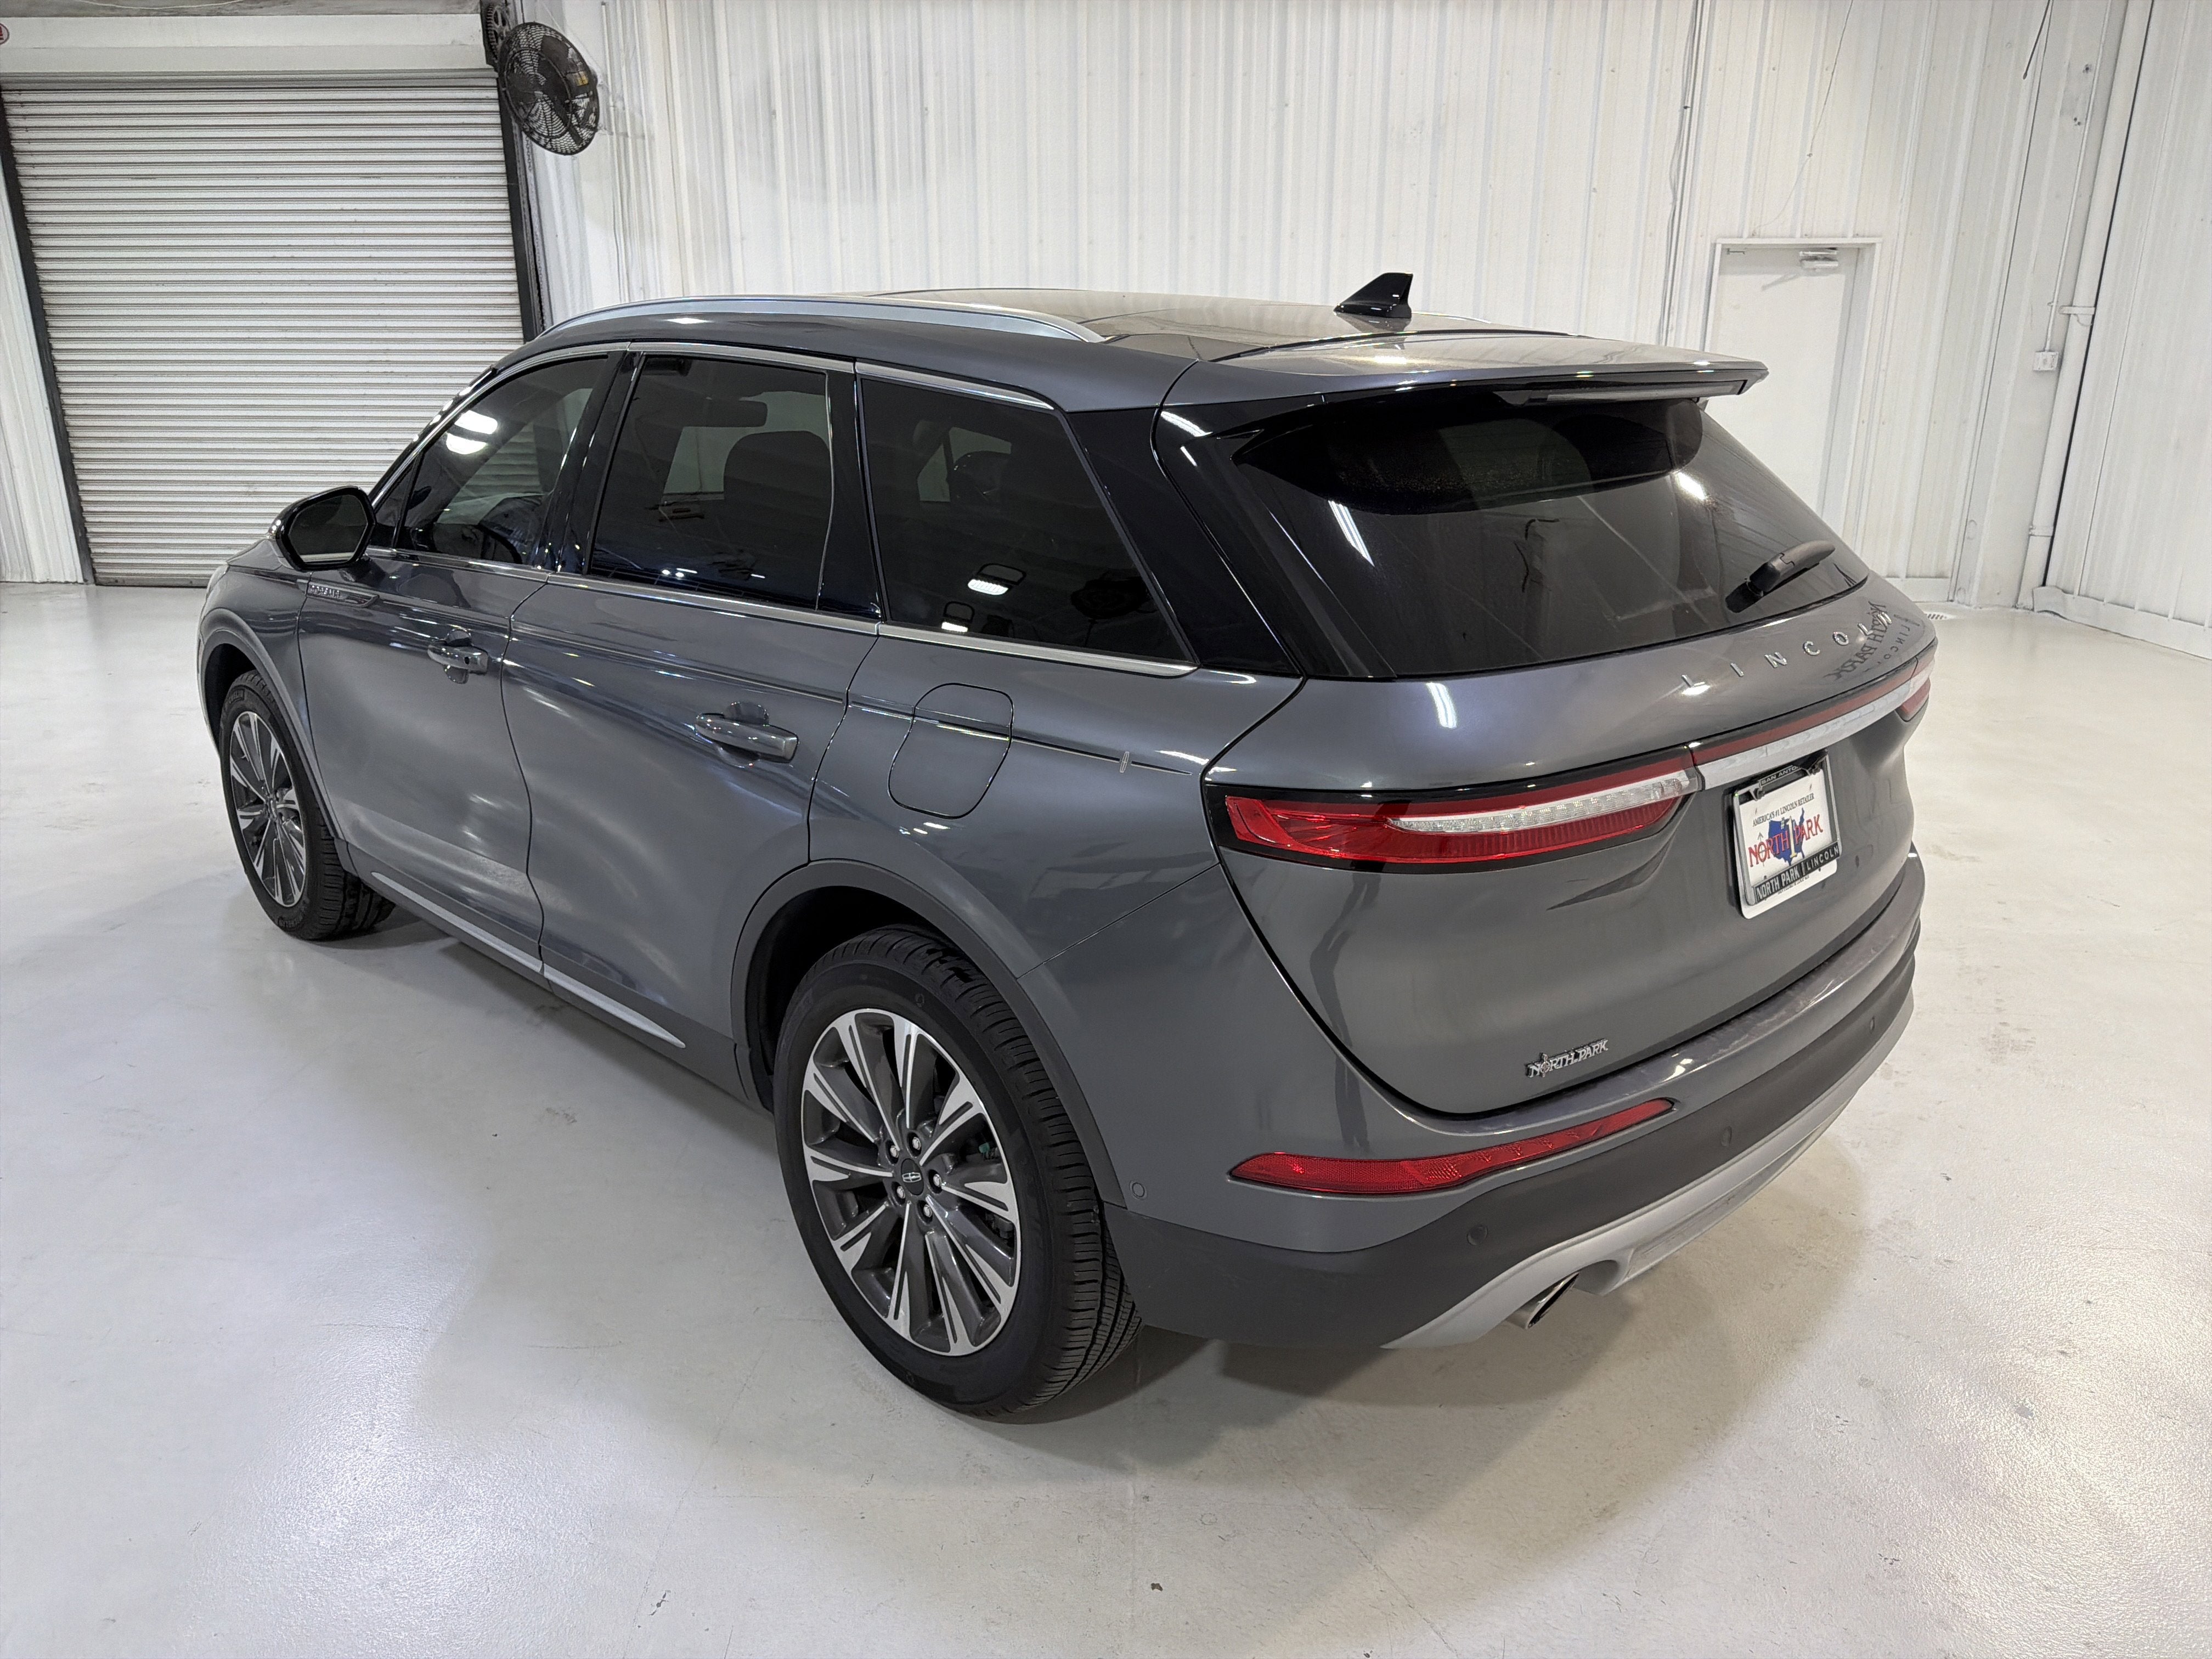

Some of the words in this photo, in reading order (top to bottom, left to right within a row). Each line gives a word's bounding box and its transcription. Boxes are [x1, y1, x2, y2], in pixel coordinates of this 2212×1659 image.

[1681, 612, 1893, 688] LINCOLN
[1761, 775, 1776, 786] SAN
[1778, 765, 1799, 777] ANTO
[1752, 810, 1775, 827] AMERICA'S
[1780, 801, 1798, 815] LINCOLN
[1798, 793, 1815, 806] RETAILER
[1748, 829, 1789, 867] NORTH
[1795, 814, 1824, 845] PARK
[1756, 876, 1780, 901] NORTH
[1781, 867, 1799, 887] PARK
[1806, 847, 1839, 870] LINCOLN
[1528, 1053, 1577, 1077] NORTH
[1577, 1039, 1609, 1062] PARK
